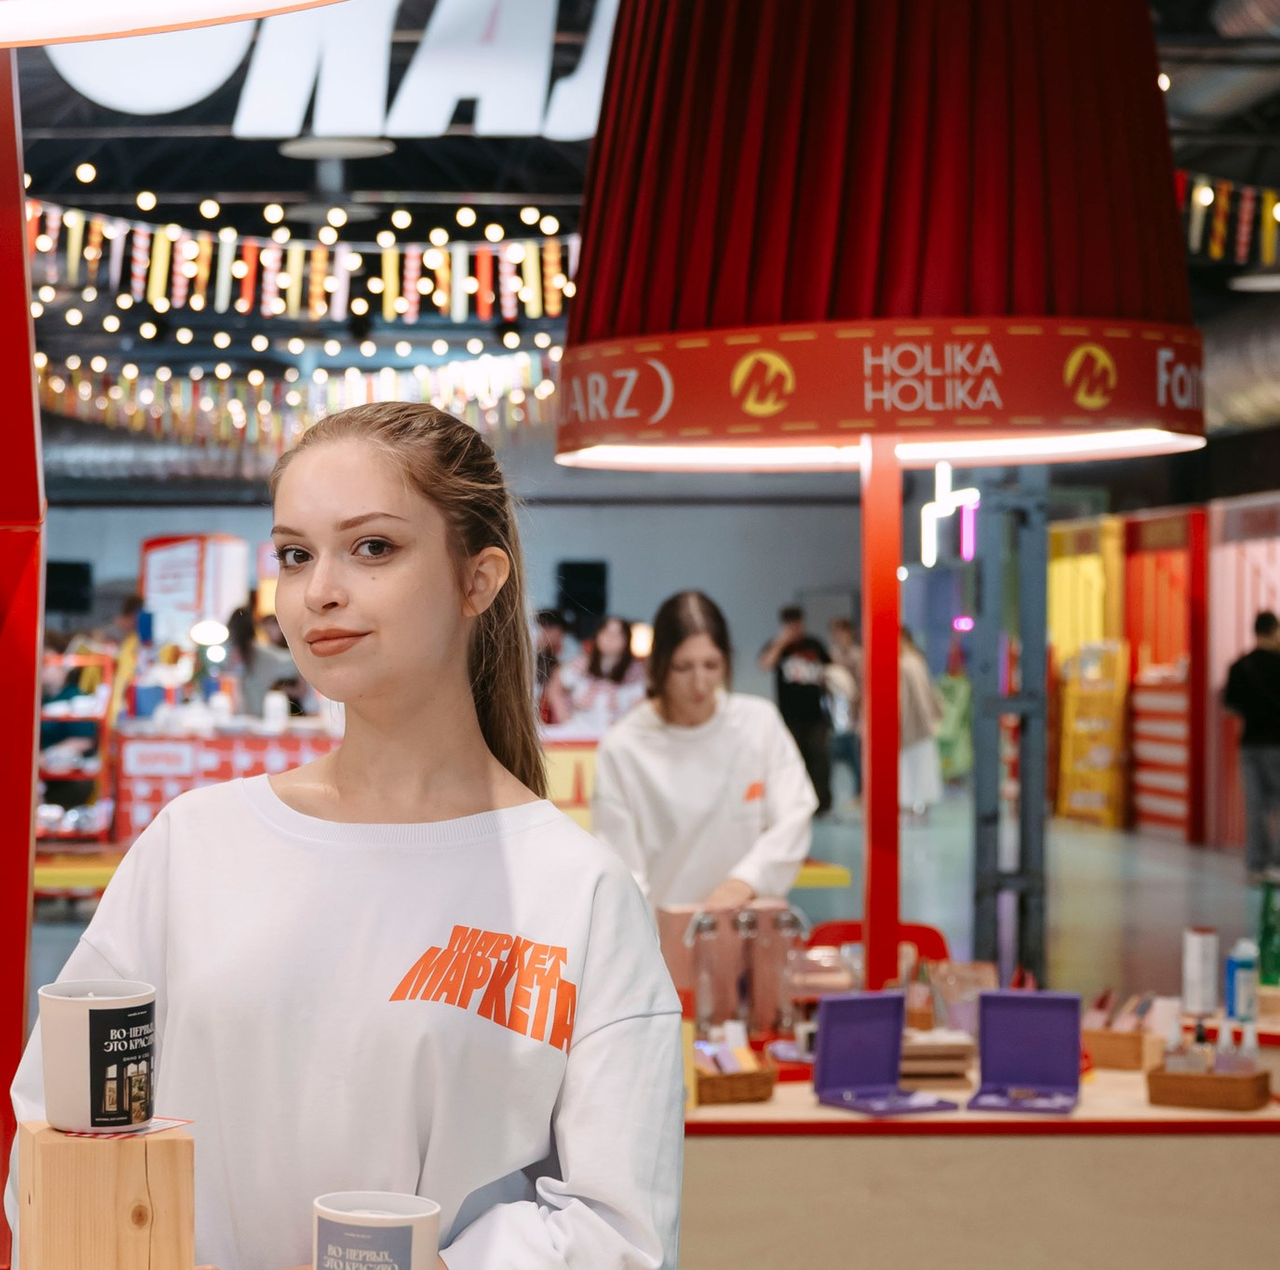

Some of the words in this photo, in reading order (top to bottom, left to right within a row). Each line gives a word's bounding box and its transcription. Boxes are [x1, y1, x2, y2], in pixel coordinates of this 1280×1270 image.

[863, 342, 1003, 377] HOLIKA
[864, 377, 1004, 412] HOLIKA
[447, 924, 568, 974] МАРКЕТ
[389, 945, 577, 1056] МАРКЕТА
[104, 1040, 128, 1052] ЭТО
